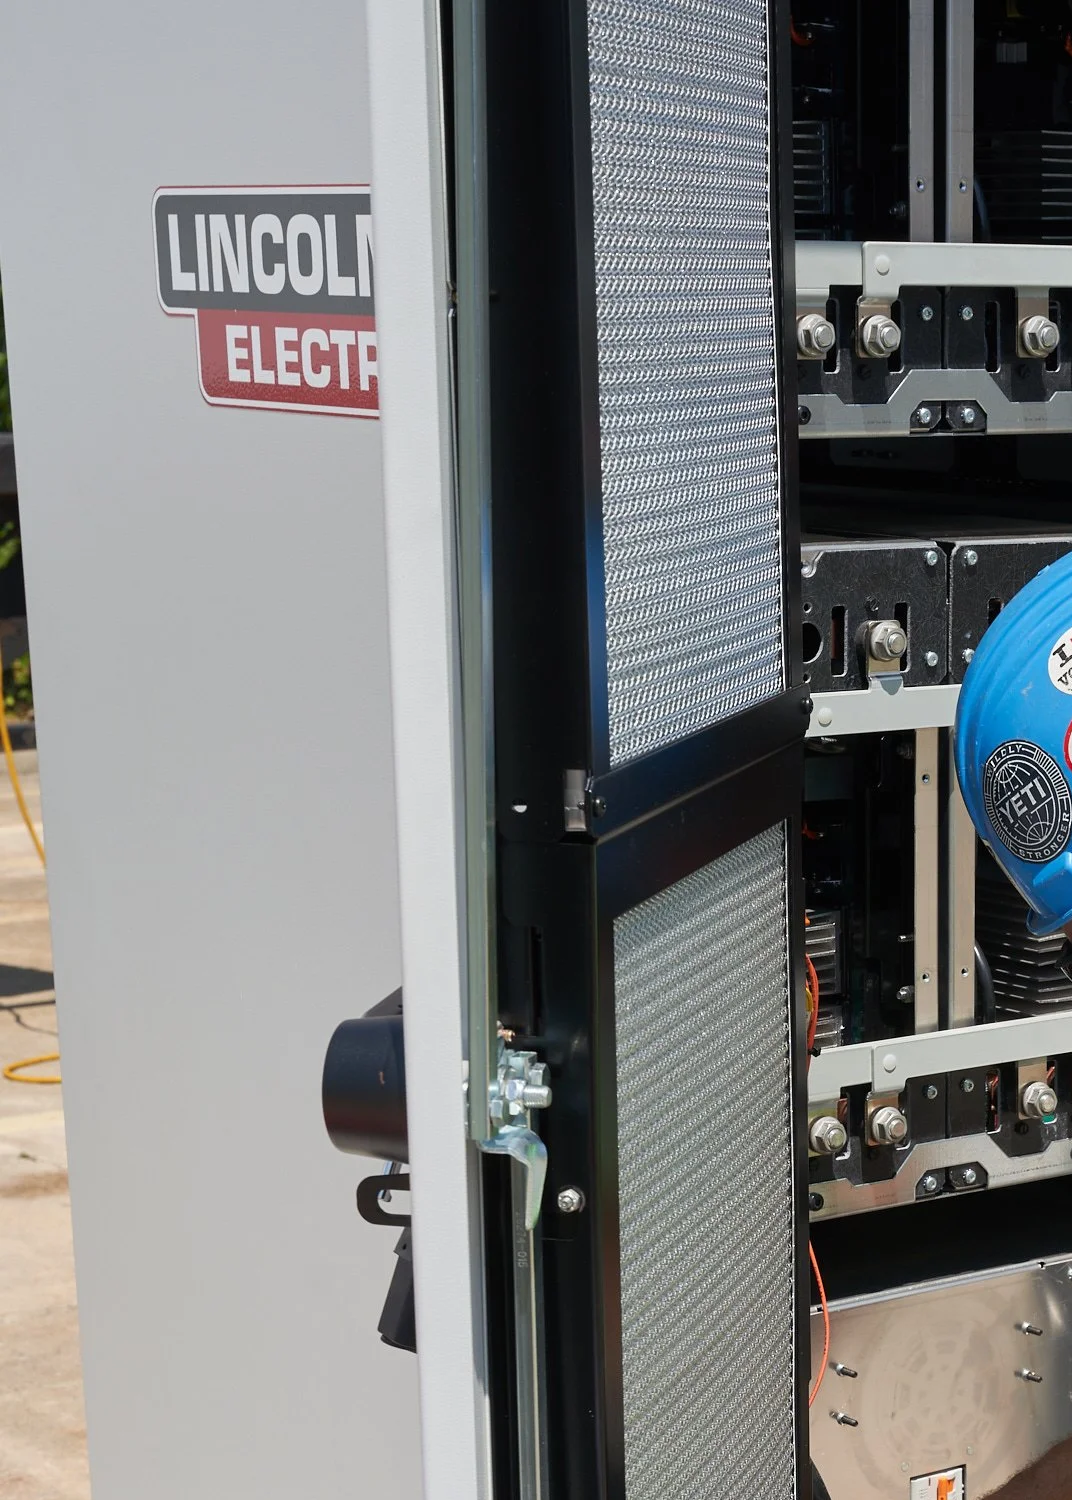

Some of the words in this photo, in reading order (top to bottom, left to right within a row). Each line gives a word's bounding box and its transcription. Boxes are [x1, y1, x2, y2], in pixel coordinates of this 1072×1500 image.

[987, 744, 1023, 777] WILDLY
[1000, 778, 1046, 824] YETI
[1019, 812, 1070, 860] STRONGER
